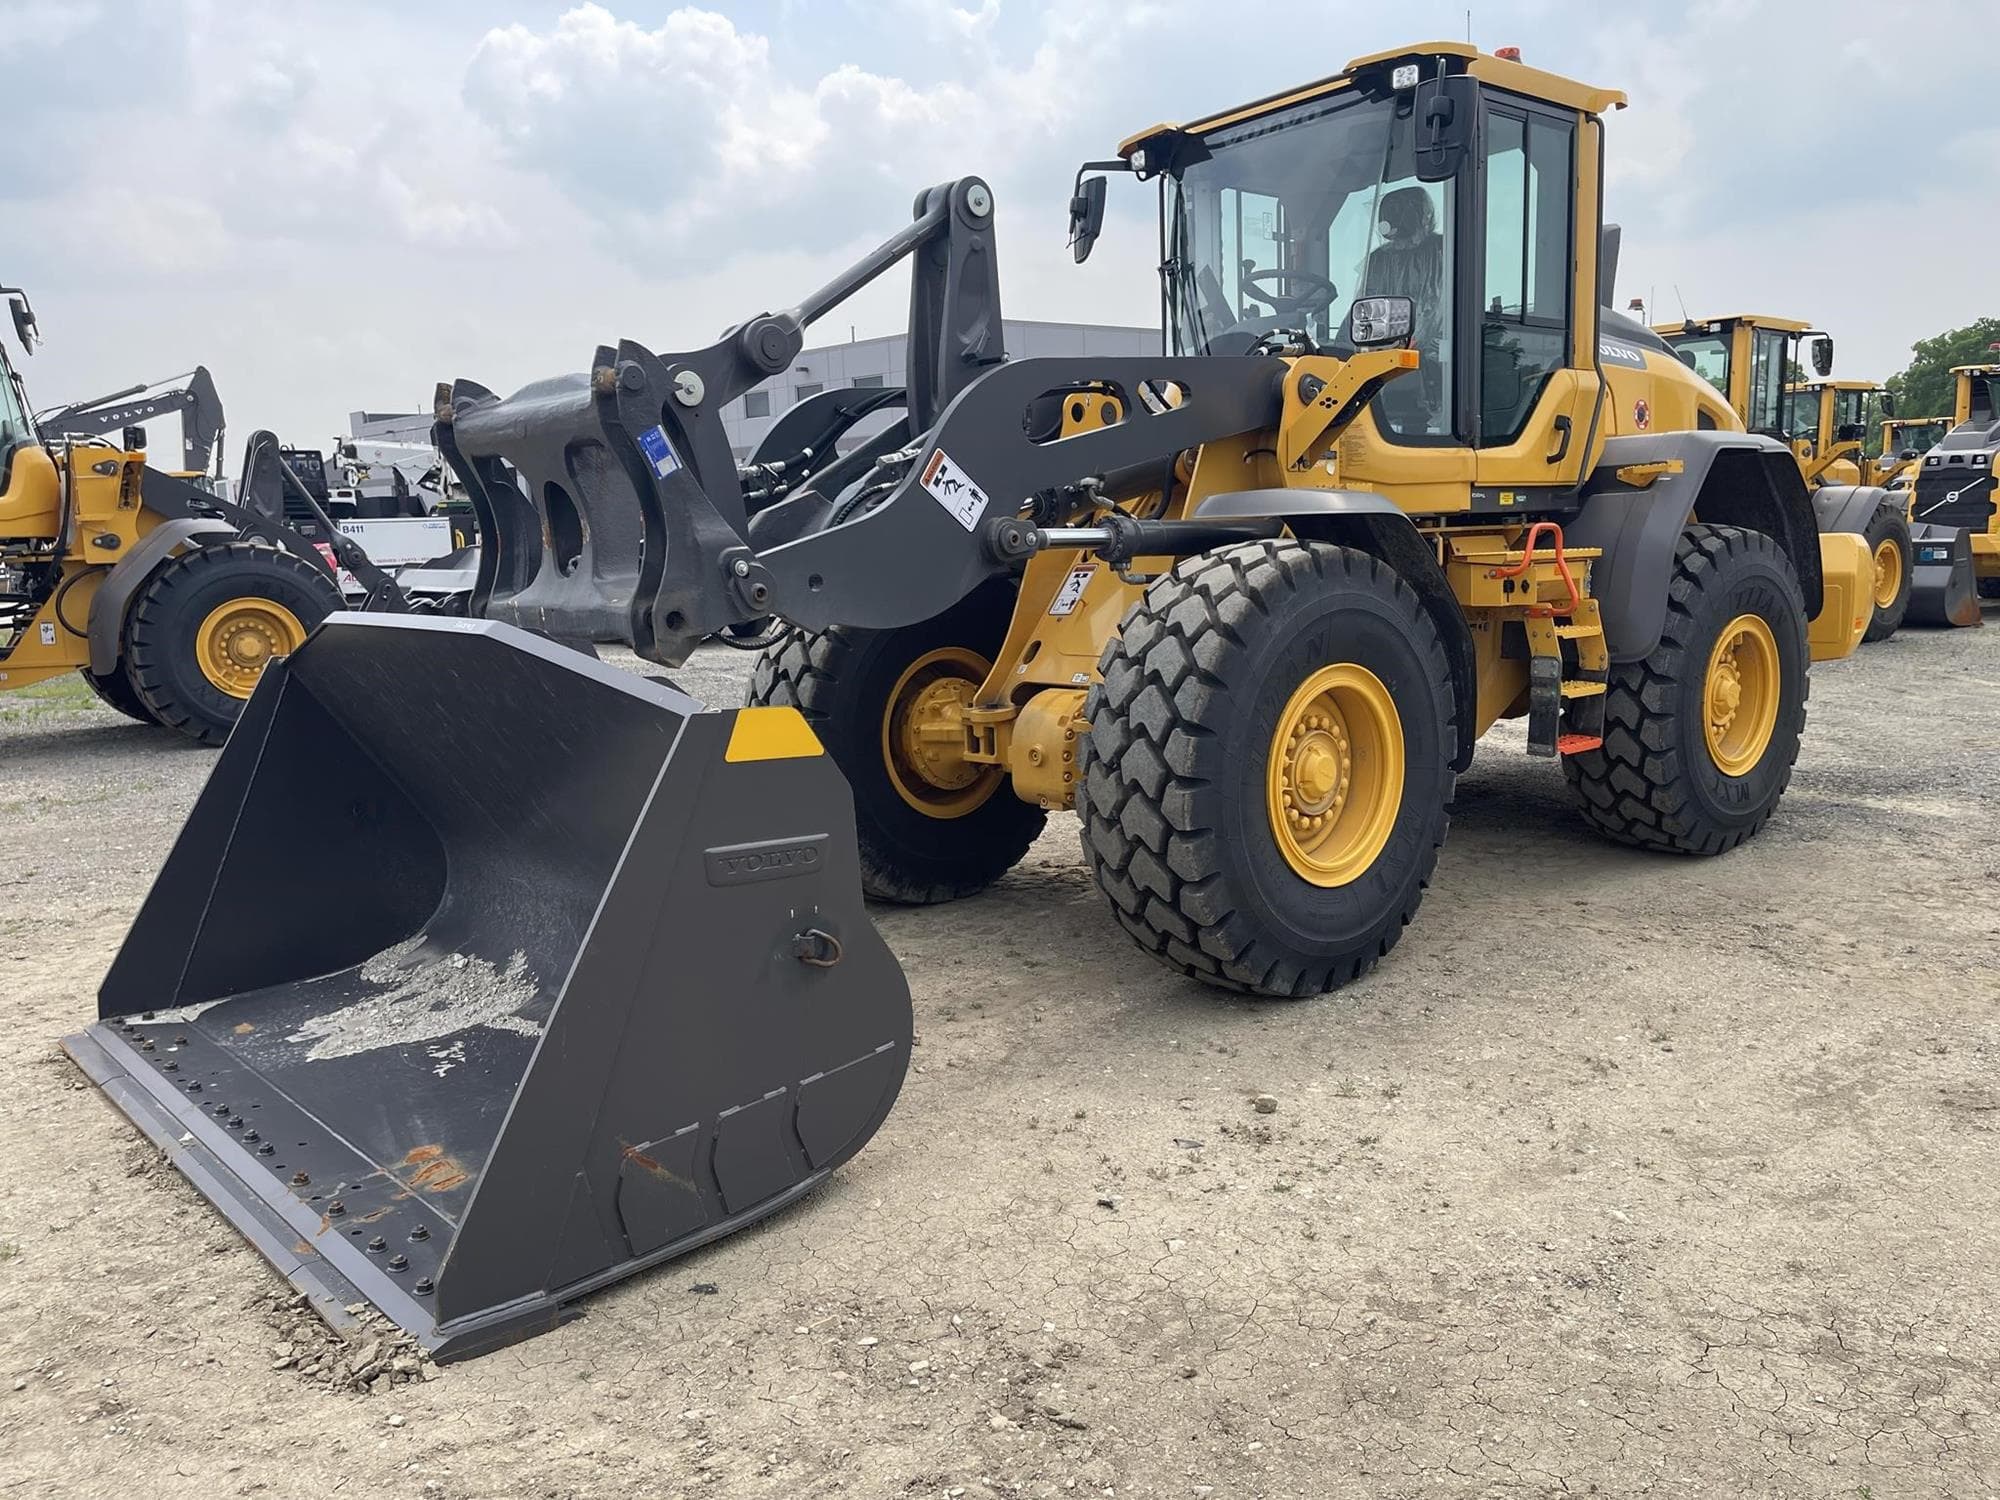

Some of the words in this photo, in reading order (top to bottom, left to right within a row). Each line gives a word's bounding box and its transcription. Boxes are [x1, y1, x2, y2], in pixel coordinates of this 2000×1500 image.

[100, 406, 154, 422] VOLVO
[342, 524, 364, 534] B411
[718, 846, 818, 875] VOLVO
